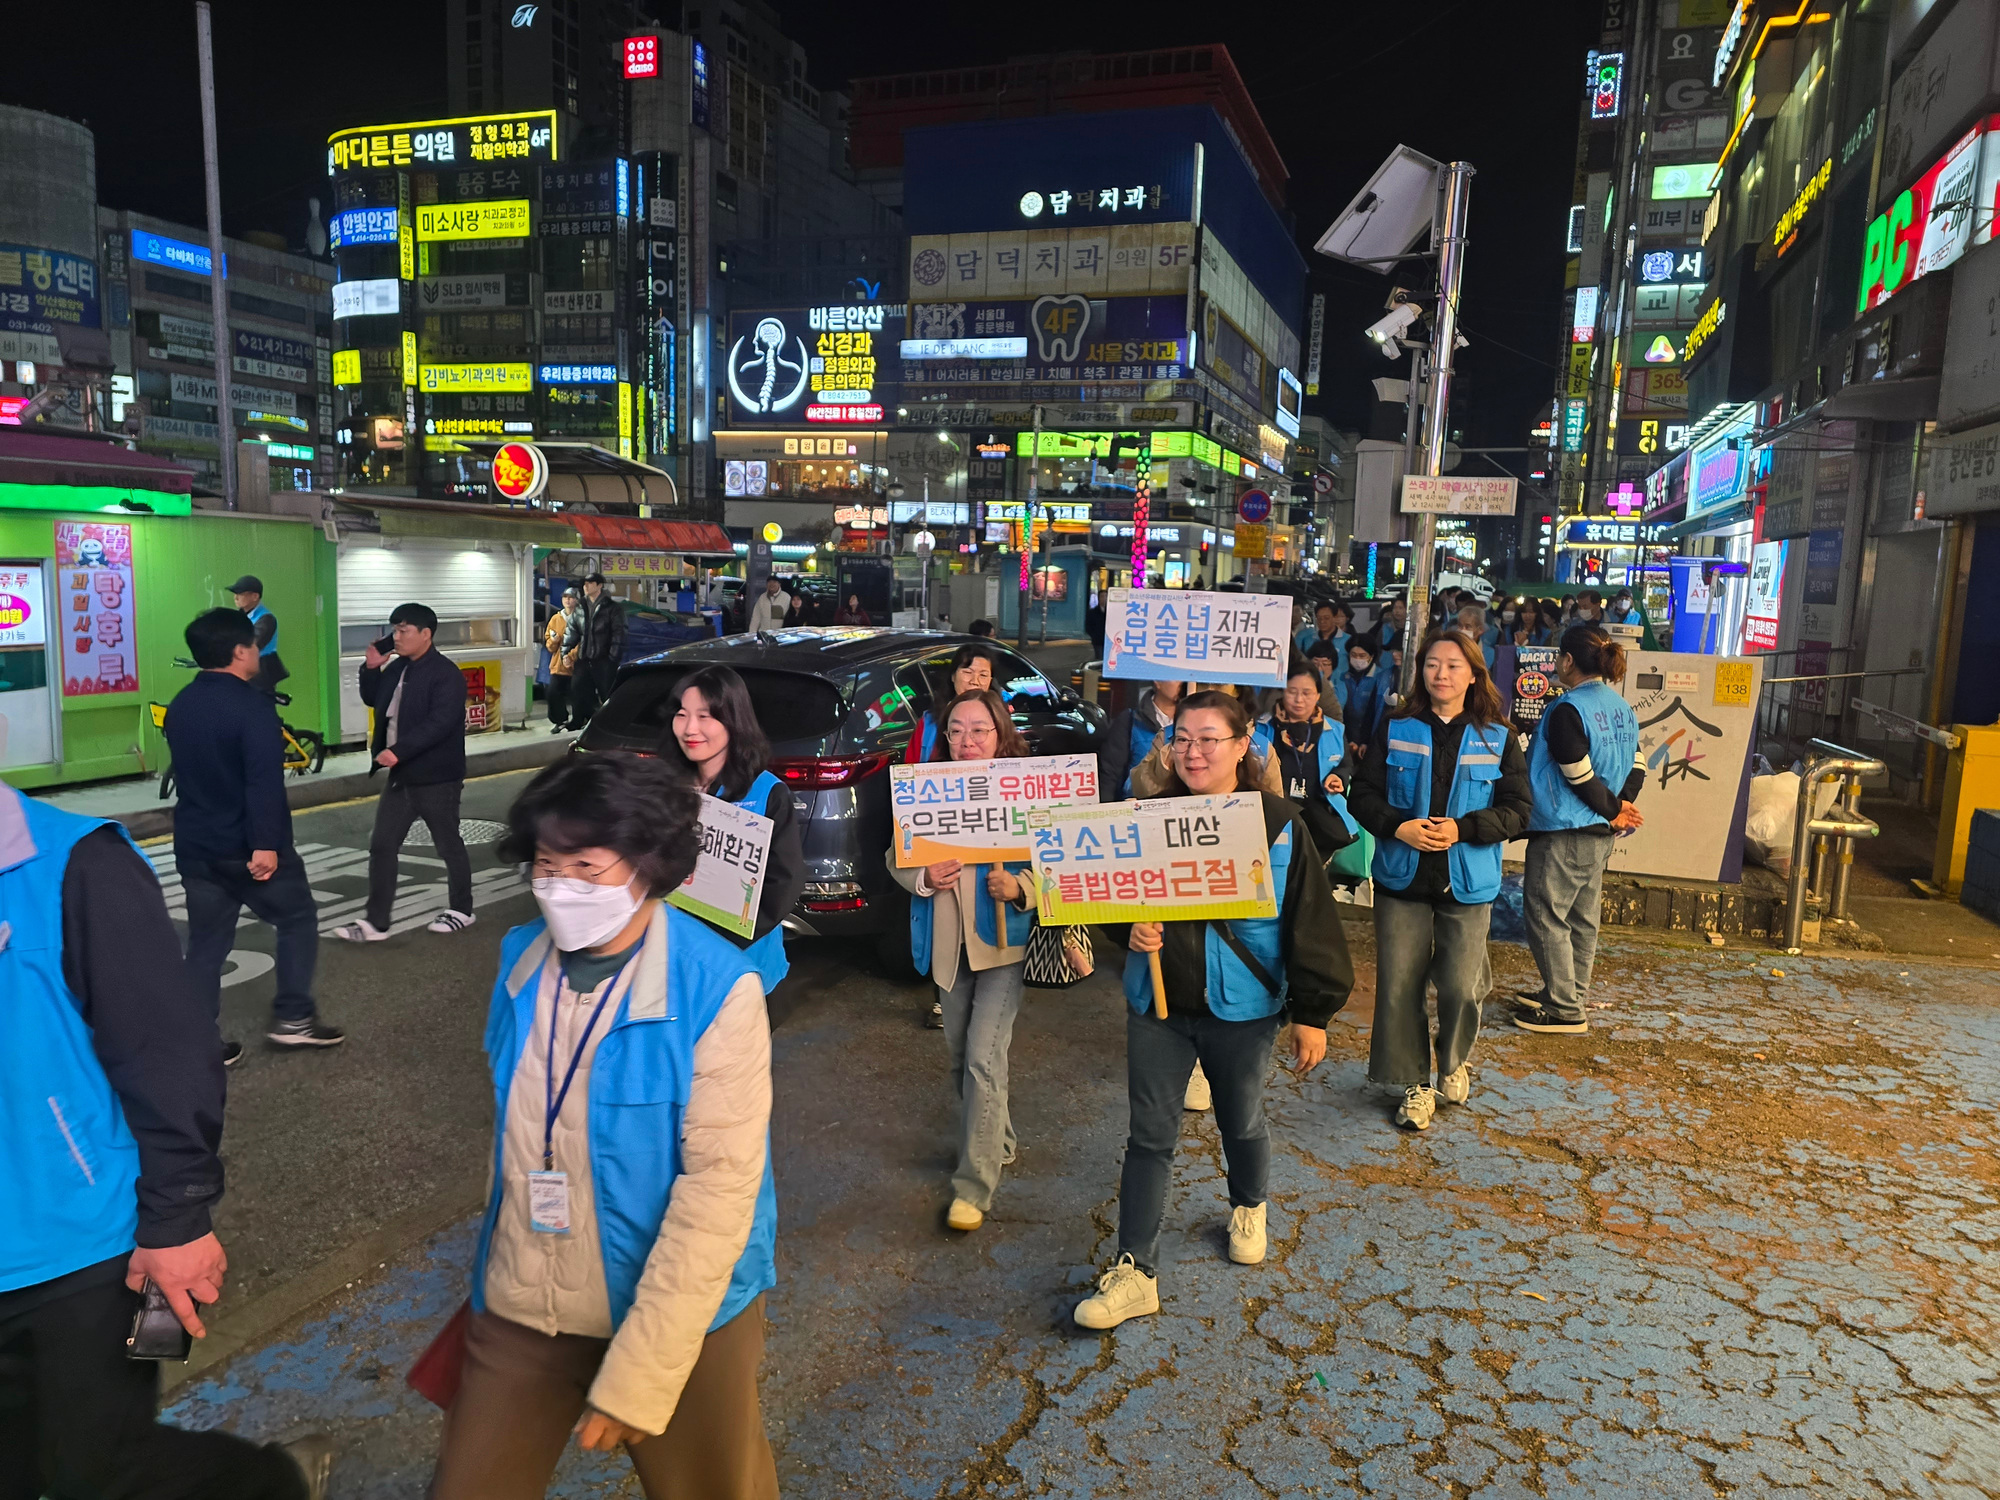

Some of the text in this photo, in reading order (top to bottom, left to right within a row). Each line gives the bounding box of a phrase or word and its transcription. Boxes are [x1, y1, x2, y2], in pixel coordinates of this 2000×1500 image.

[1605, 0, 1621, 28] VD
[470, 122, 530, 143] 정형외과
[531, 129, 550, 147] 6F
[334, 131, 455, 170] 마디튼튼의원
[470, 140, 530, 160] 재활의학과
[1049, 185, 1147, 215] 담덕치과
[422, 206, 526, 234] 미소사랑 치과교정과
[540, 221, 612, 236] 우리통증의학과
[1647, 210, 1681, 227] 피부
[1858, 190, 1913, 313] PC
[955, 243, 1188, 282] 담덕치과 의원 5F
[442, 283, 463, 297] SLB
[652, 241, 675, 336] 다이소
[567, 293, 603, 311] 산부인과
[809, 305, 884, 331] 바른안산
[975, 309, 1005, 321] 서울대
[1043, 307, 1078, 335] 4F
[975, 321, 1015, 334] 동문병원
[816, 332, 873, 356] 신경과
[933, 344, 946, 355] DE
[950, 343, 985, 355] BLANC
[1085, 341, 1178, 363] 서울S치과
[541, 366, 612, 381] 우리통증의학과
[824, 357, 877, 374] 정형외과
[936, 368, 980, 381] 어지러움
[1048, 366, 1071, 380] 치매
[1083, 366, 1107, 379] 척추
[1119, 365, 1143, 379] 관절
[1156, 364, 1181, 379] 통증
[424, 367, 507, 388] 김비뇨기과의원
[810, 373, 876, 391] 통증의학과
[1653, 373, 1684, 390] 365
[176, 380, 199, 397] 시화
[969, 460, 1003, 479] 미인
[1408, 480, 1437, 491] 쓰레기
[1487, 482, 1508, 493] 안내
[1618, 492, 1632, 507] 약
[58, 523, 80, 549] 새콤
[105, 528, 128, 551] 달콤
[1585, 524, 1636, 542] 휴대폰
[602, 556, 675, 572] 중앙떡볶이
[1691, 589, 1708, 598] AT
[71, 573, 93, 654] 과일사랑
[1126, 601, 1260, 633] 청소년 지켜
[94, 571, 125, 688] 탕후루
[1123, 631, 1277, 660] 보호법 주세요
[1519, 652, 1547, 663] BACK
[1546, 687, 1564, 696] 소주
[1724, 683, 1748, 695] 138
[1805, 679, 1825, 701] PC
[1594, 707, 1635, 733] 안산시
[894, 771, 1097, 806] 청소년을 유해환경
[912, 806, 1009, 837] 으로부터
[1034, 815, 1221, 863] 청소년 대상
[698, 825, 764, 875] 해환경
[1058, 858, 1239, 903] 불법영업 근절
